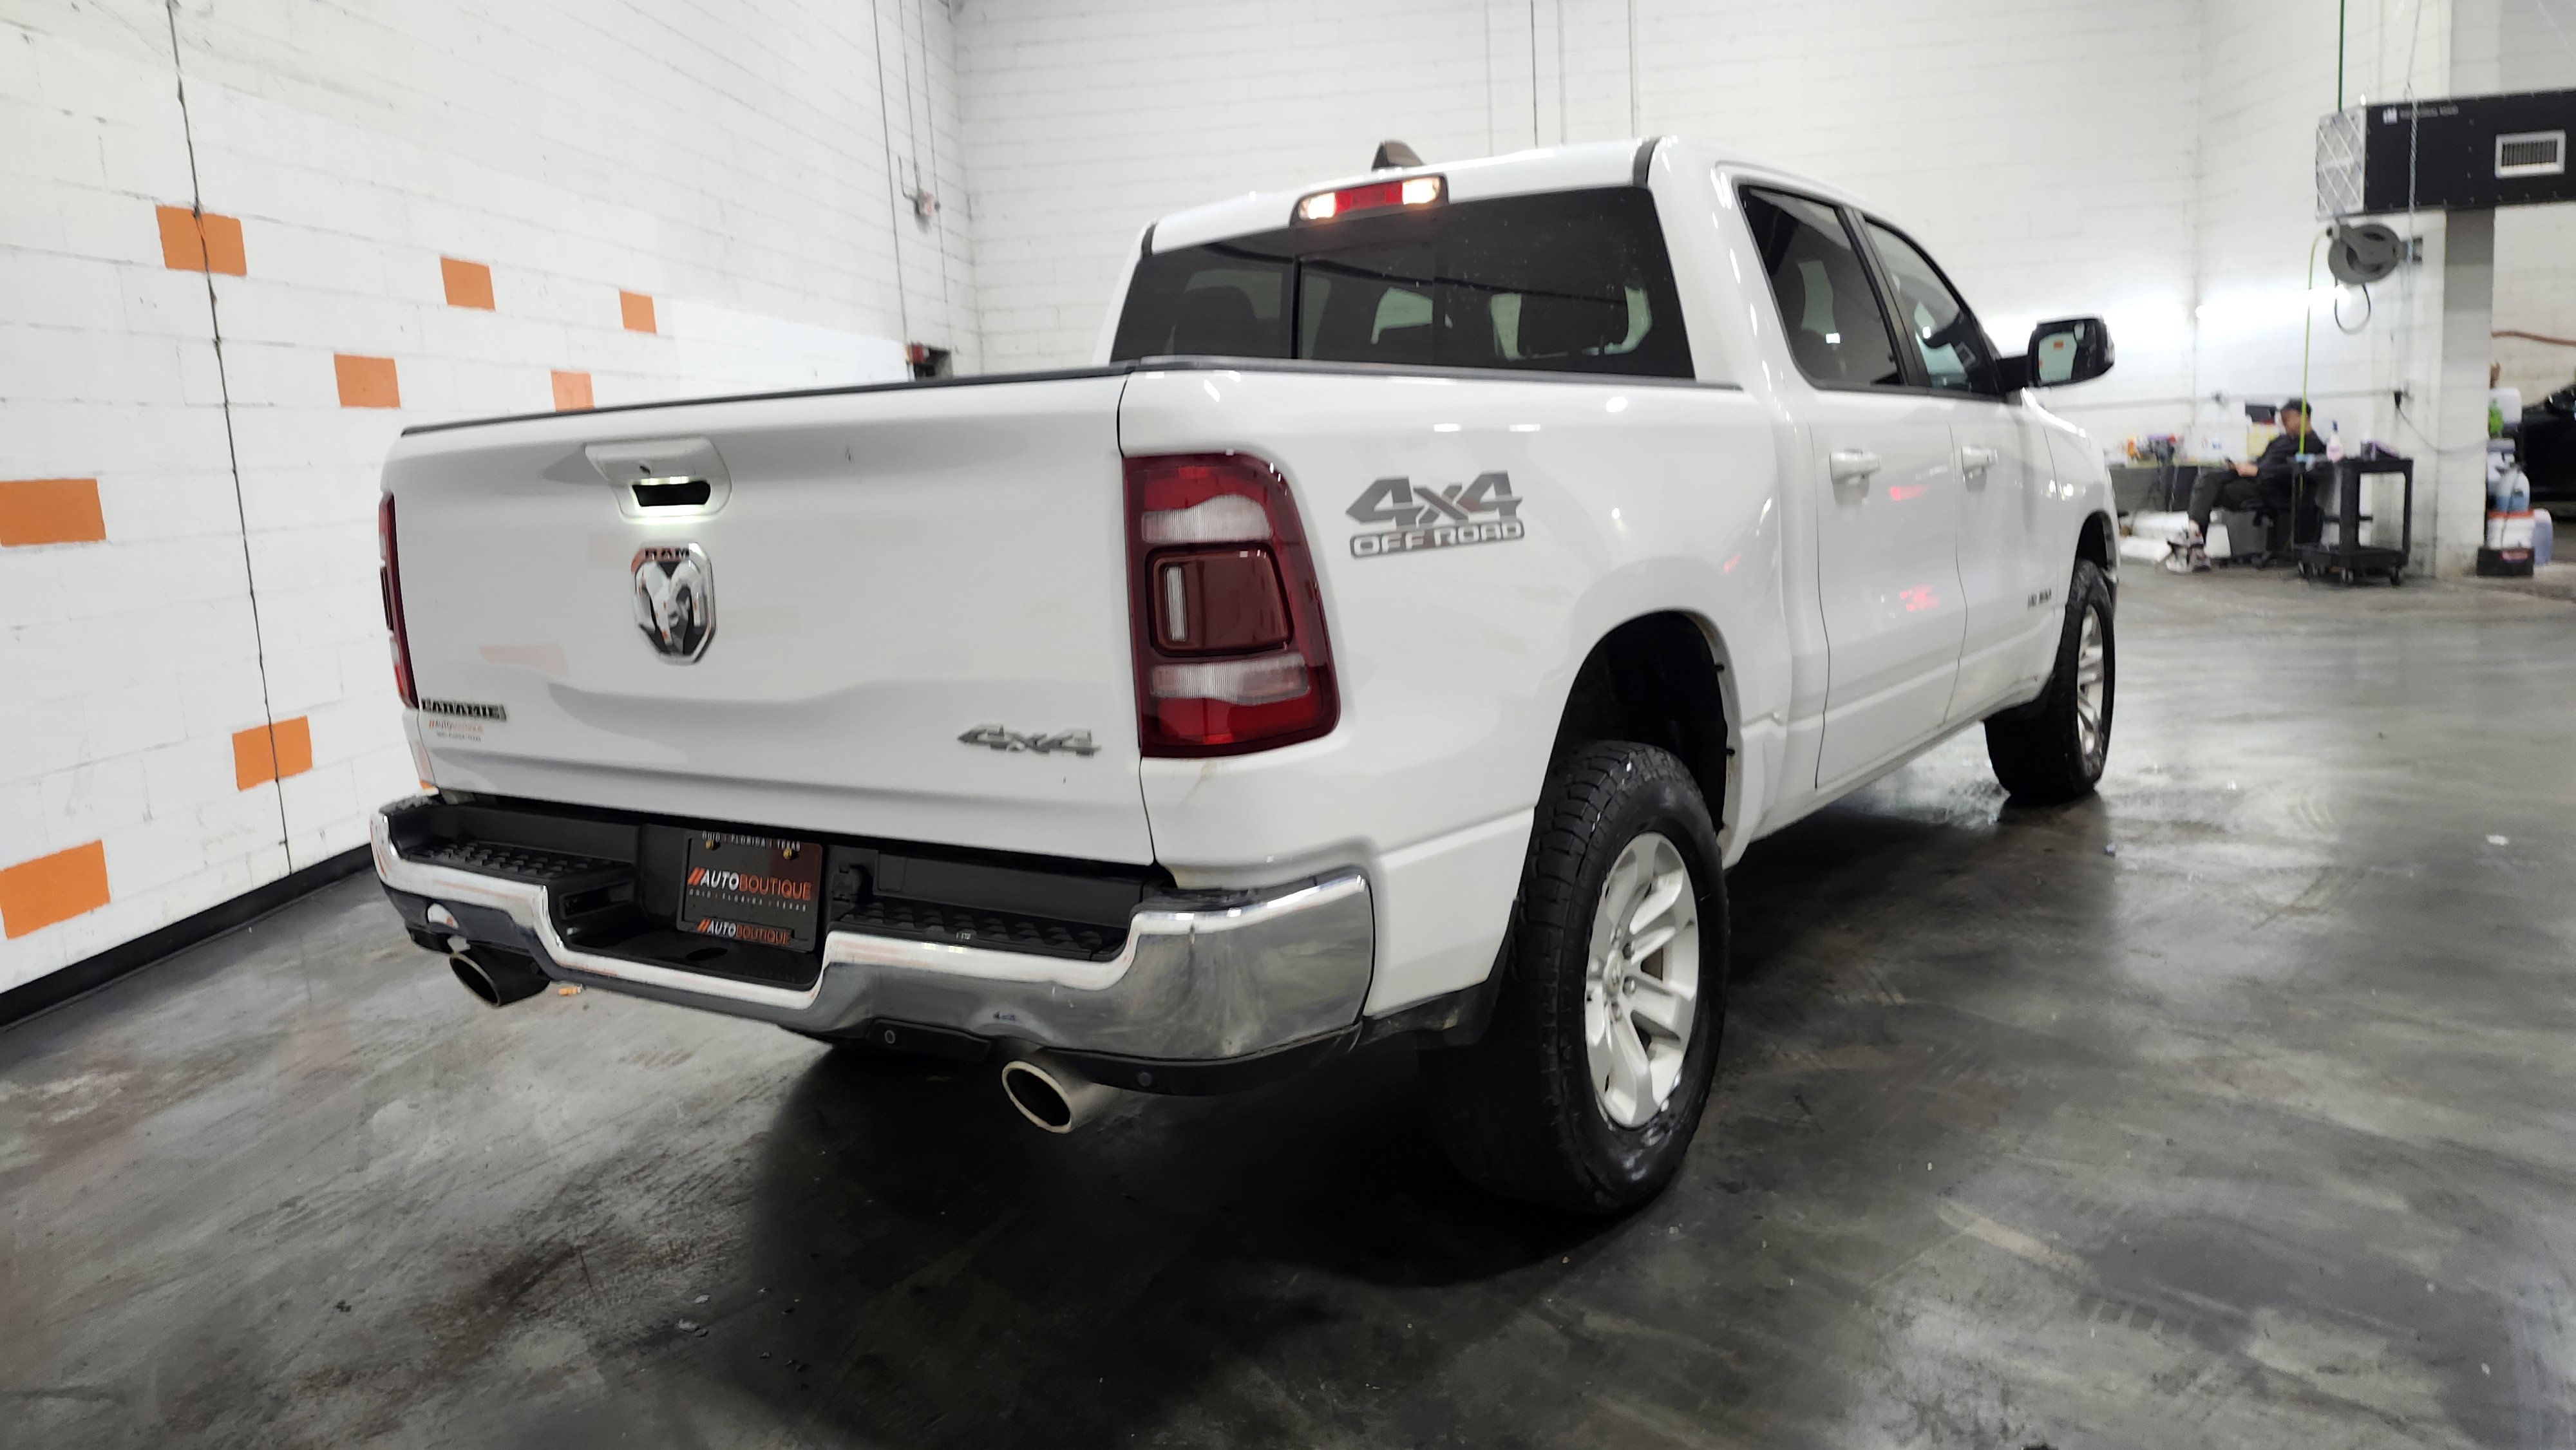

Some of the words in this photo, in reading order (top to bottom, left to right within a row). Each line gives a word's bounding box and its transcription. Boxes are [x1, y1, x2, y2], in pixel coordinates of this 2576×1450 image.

[1353, 529, 1426, 555] OFF
[1434, 521, 1522, 546] ROAD
[645, 548, 690, 560] RAM
[421, 698, 505, 720] LARAMIE
[702, 831, 721, 843] OHIO
[731, 834, 766, 848] FLORIDA
